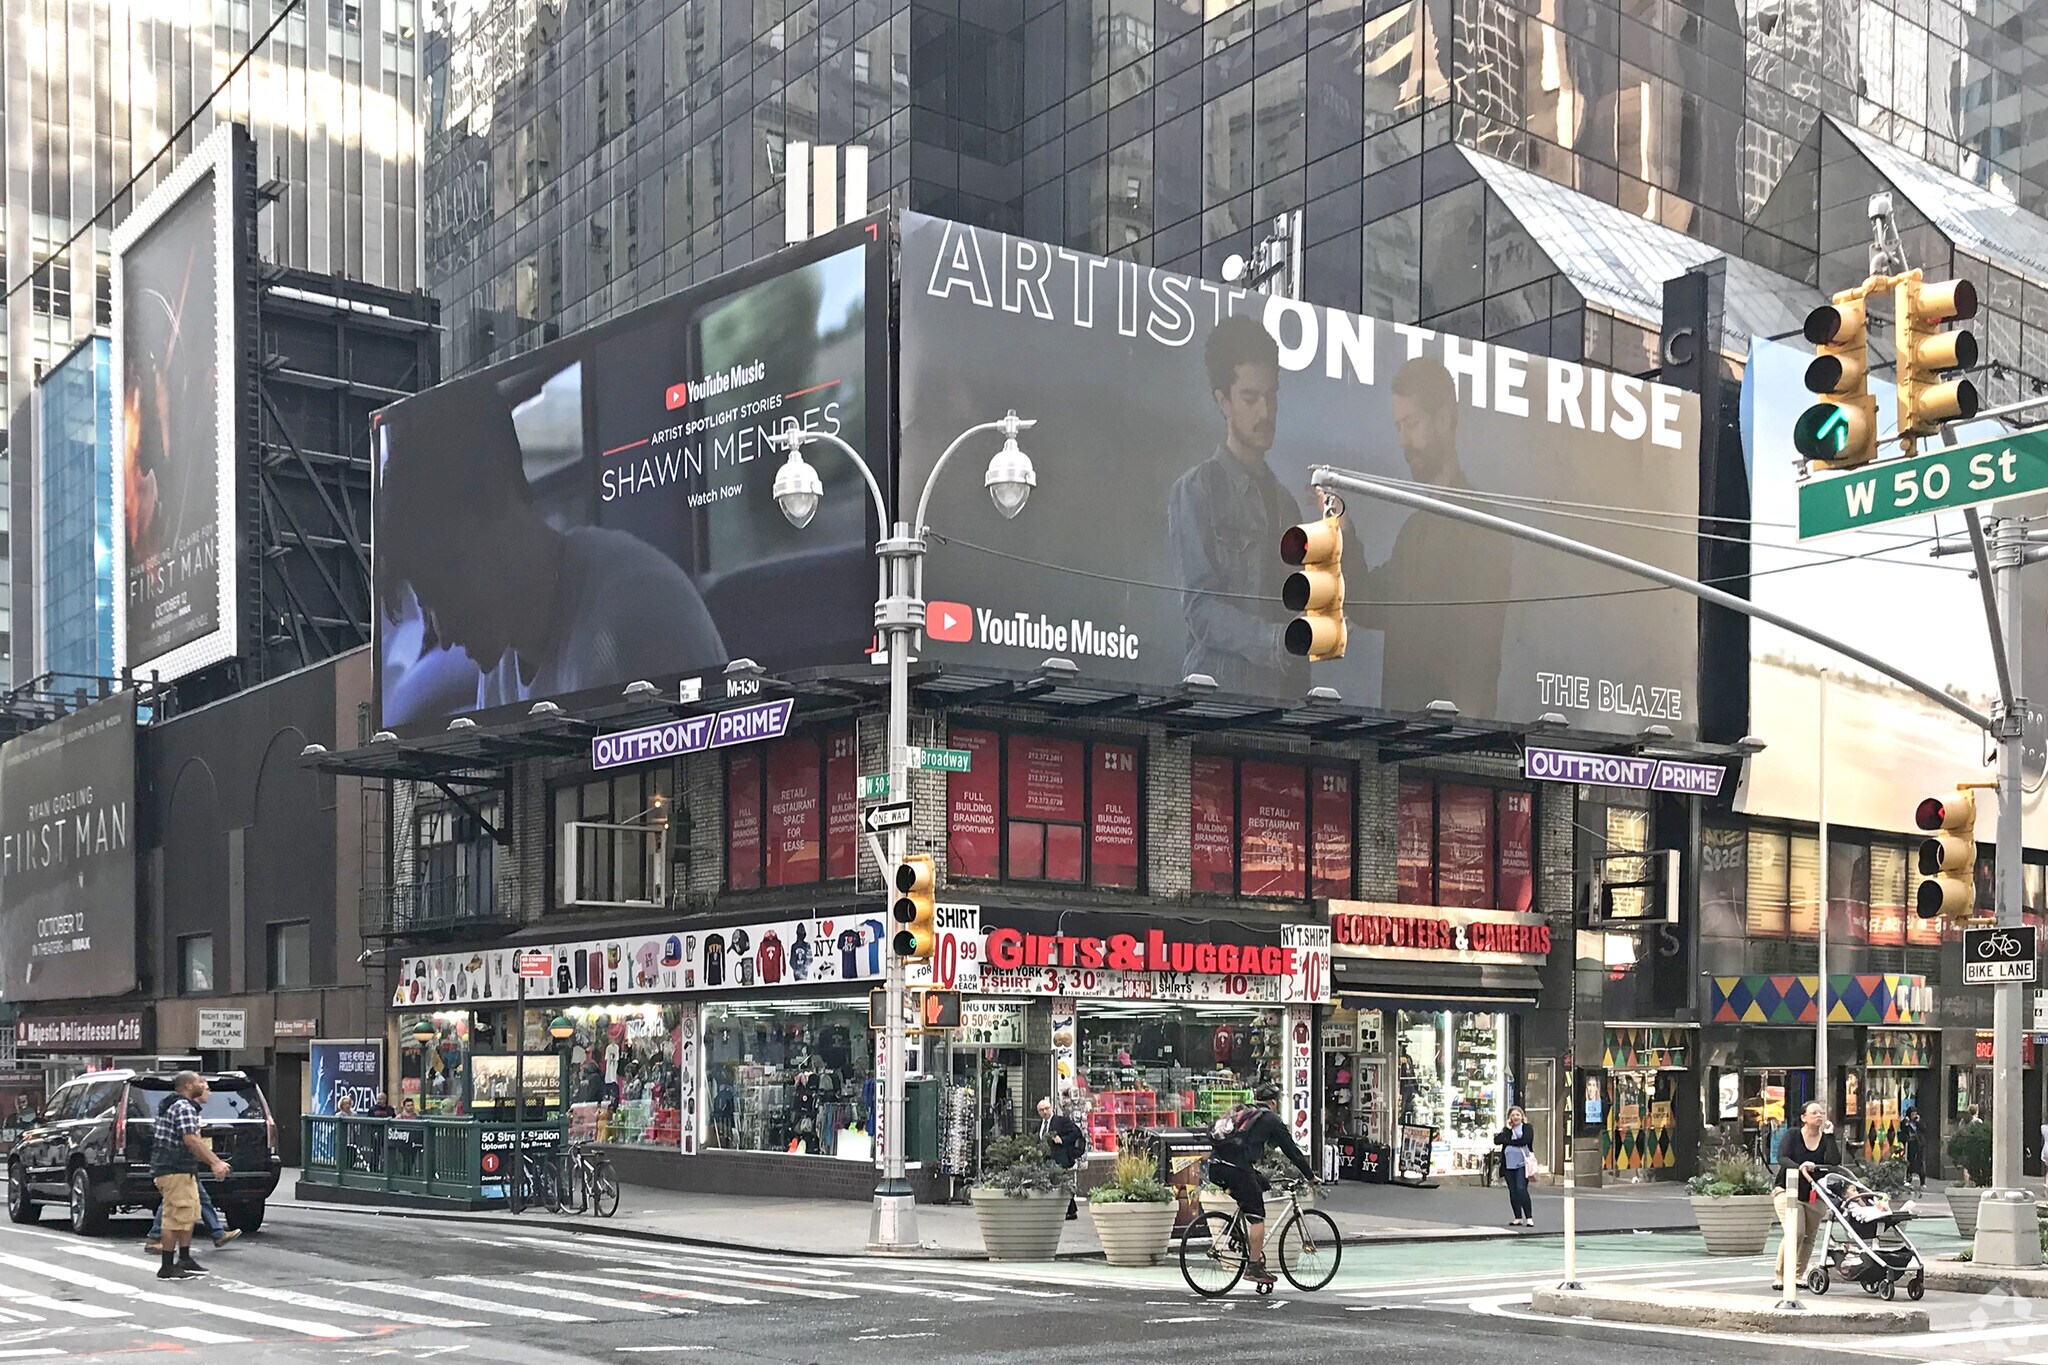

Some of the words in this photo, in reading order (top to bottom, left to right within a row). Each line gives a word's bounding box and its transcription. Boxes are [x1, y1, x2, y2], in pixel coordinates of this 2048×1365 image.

[927, 220, 1246, 347] ARTIST
[1263, 293, 1374, 386] ON
[1394, 322, 1529, 418] THE
[1547, 356, 1682, 450] RISE
[687, 373, 729, 403] YouTube
[730, 359, 765, 388] Music
[651, 425, 683, 446] ARTIST
[685, 408, 738, 436] SPOTLIGHT
[740, 394, 782, 418] STORIES
[601, 443, 702, 502] SHAWN
[714, 402, 841, 470] MENDES
[1845, 478, 1877, 518] W
[1893, 463, 1950, 507] 50
[1968, 447, 2017, 491] St
[687, 490, 717, 507] Watch
[720, 483, 742, 498] Now
[181, 538, 214, 581] MAN
[976, 607, 1068, 652] YouTube
[1071, 619, 1139, 660] Music
[1537, 672, 1589, 709] THE
[1598, 679, 1681, 721] BLAZE
[597, 720, 706, 764] OUTFRONT
[720, 706, 782, 741] PRIME
[921, 750, 969, 772] Broadway
[1532, 751, 1650, 785] OUTFRONT
[1662, 766, 1717, 791] PRIME
[866, 778, 873, 794] W
[875, 776, 885, 793] 50
[53, 785, 94, 814] GOSLING
[781, 787, 807, 799] RETAIL/
[838, 792, 852, 801] FULL
[964, 791, 984, 801] FULL
[772, 799, 816, 814] RESTAURANT
[956, 802, 992, 813] BUILDING
[1105, 804, 1123, 813] FULL
[783, 814, 805, 827] SPACE
[873, 812, 888, 824] ONE
[891, 811, 906, 822] WAY
[953, 812, 994, 824] BRANDING
[1098, 814, 1130, 824] BUILDING
[1204, 814, 1220, 823] FULL
[1249, 818, 1300, 831] RESTAURANT
[76, 802, 126, 858] MAN
[787, 828, 801, 838] FOR
[953, 824, 995, 834] OPPORTUNITY
[1096, 825, 1132, 835] BRANDING
[1197, 824, 1227, 833] BUILDING
[1095, 836, 1133, 844] OPPORTUNITY
[1195, 834, 1229, 843] BRANDING
[1262, 831, 1287, 842] SPACE
[783, 839, 805, 851] LEASE
[38, 914, 74, 938] OCTOBER
[816, 921, 821, 938] I
[1282, 926, 1296, 946] NY
[1297, 927, 1330, 948] T.SHIRT
[1333, 913, 1450, 948] COMPUTERS
[1456, 925, 1469, 950] &
[1471, 921, 1551, 954] CAMERAS
[814, 939, 836, 957] NY
[961, 942, 977, 960] 99
[985, 928, 1103, 969] GIFTS
[1105, 933, 1145, 971] &
[1145, 928, 1298, 976] LUGGAGE
[1320, 953, 1329, 971] 99
[917, 965, 932, 979] FOR
[1016, 966, 1042, 977] YORK
[1968, 964, 1993, 977] BIKE
[2000, 963, 2031, 977] LANE
[1044, 968, 1058, 992] 3
[1159, 972, 1178, 984] NY
[958, 982, 978, 991] EACH
[1159, 983, 1192, 993] SHIRTS
[982, 1003, 995, 1012] ON
[998, 1003, 1022, 1013] SALE
[28, 1022, 59, 1047] Majestic
[60, 1022, 117, 1041] Delicatessen
[118, 1018, 140, 1040] Café
[1294, 1057, 1310, 1067] NY
[388, 1129, 410, 1143] Subway
[481, 1132, 495, 1142] 50
[497, 1132, 525, 1142] Stret
[481, 1142, 507, 1152] Uptown
[1362, 1161, 1378, 1172] NY
